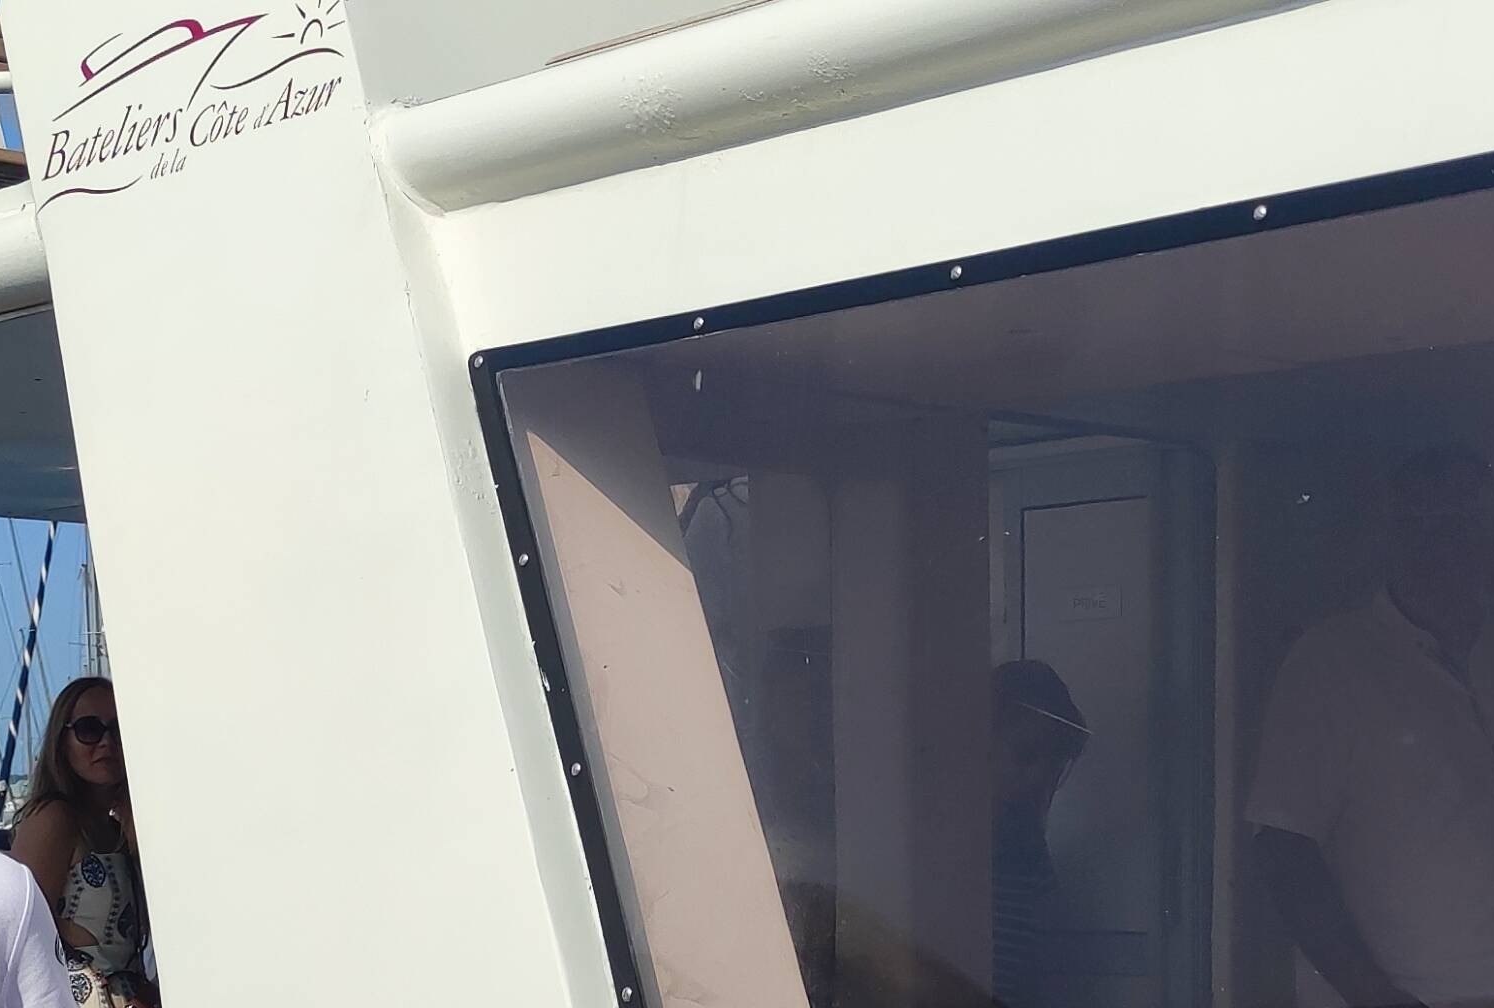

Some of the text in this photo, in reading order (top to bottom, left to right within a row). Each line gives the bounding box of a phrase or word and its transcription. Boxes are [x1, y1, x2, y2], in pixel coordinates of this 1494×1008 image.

[42, 104, 184, 181] Bateliers
[190, 101, 247, 147] Côte
[150, 149, 185, 180] de la
